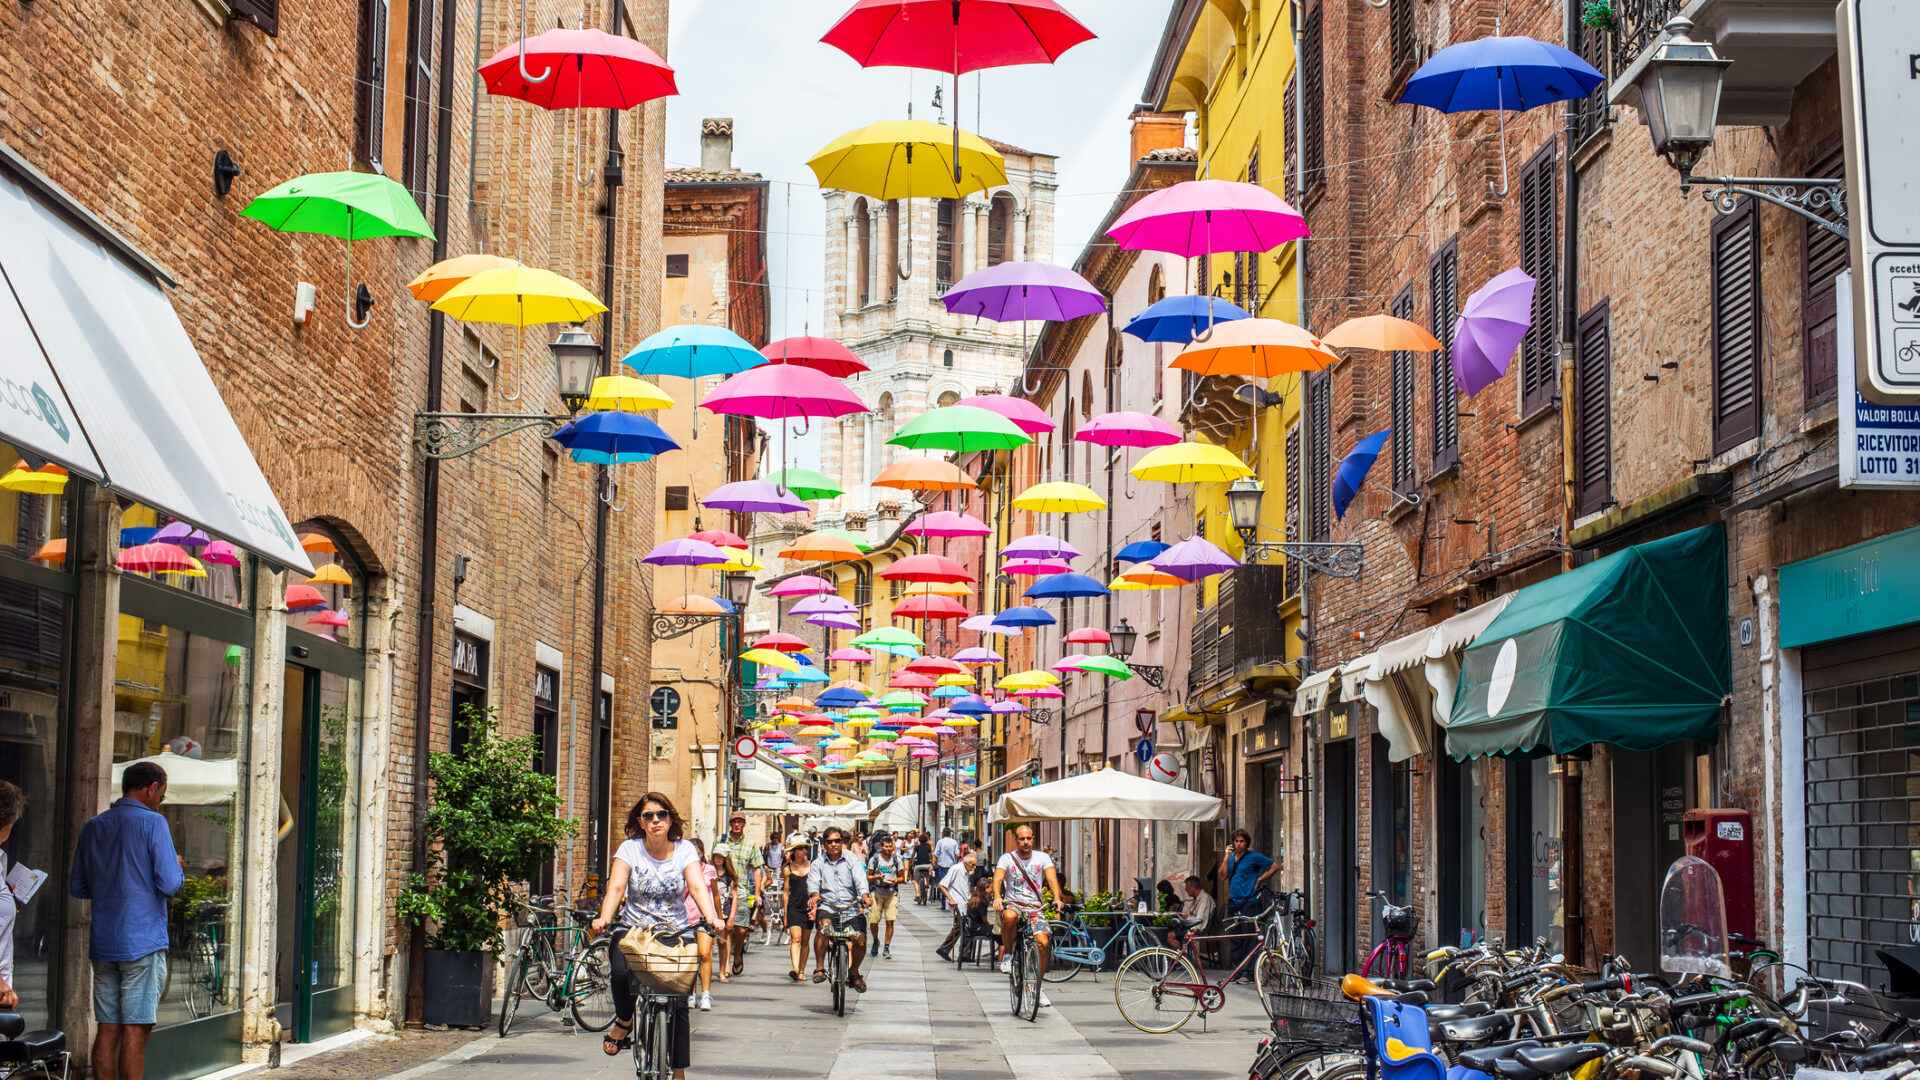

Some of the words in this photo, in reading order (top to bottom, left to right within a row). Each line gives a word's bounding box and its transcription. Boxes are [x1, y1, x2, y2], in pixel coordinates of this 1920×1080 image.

[1857, 409, 1889, 422] VALORI
[1860, 456, 1898, 475] LOTTO
[1741, 622, 1751, 642] 69
